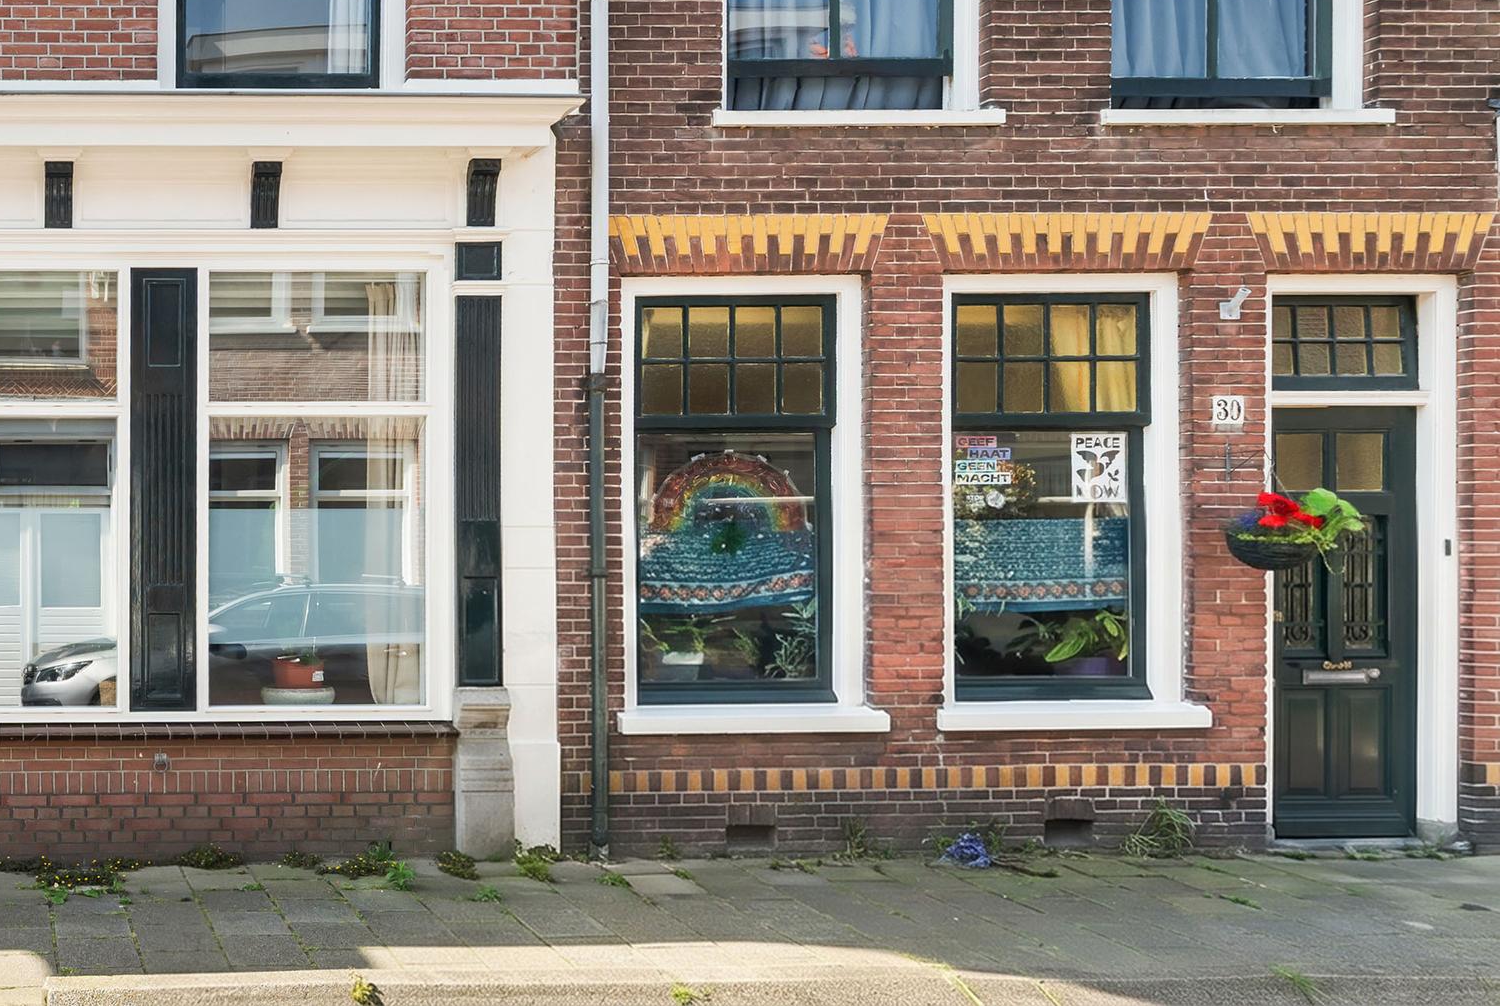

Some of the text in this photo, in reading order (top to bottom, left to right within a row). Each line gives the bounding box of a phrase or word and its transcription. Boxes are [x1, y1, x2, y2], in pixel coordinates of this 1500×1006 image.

[1216, 399, 1242, 421] 30
[958, 437, 995, 447] GEEF
[1076, 437, 1120, 448] PEACE
[969, 449, 1010, 459] HAAT
[957, 462, 996, 471] GEEN
[956, 474, 1010, 483] MACHT
